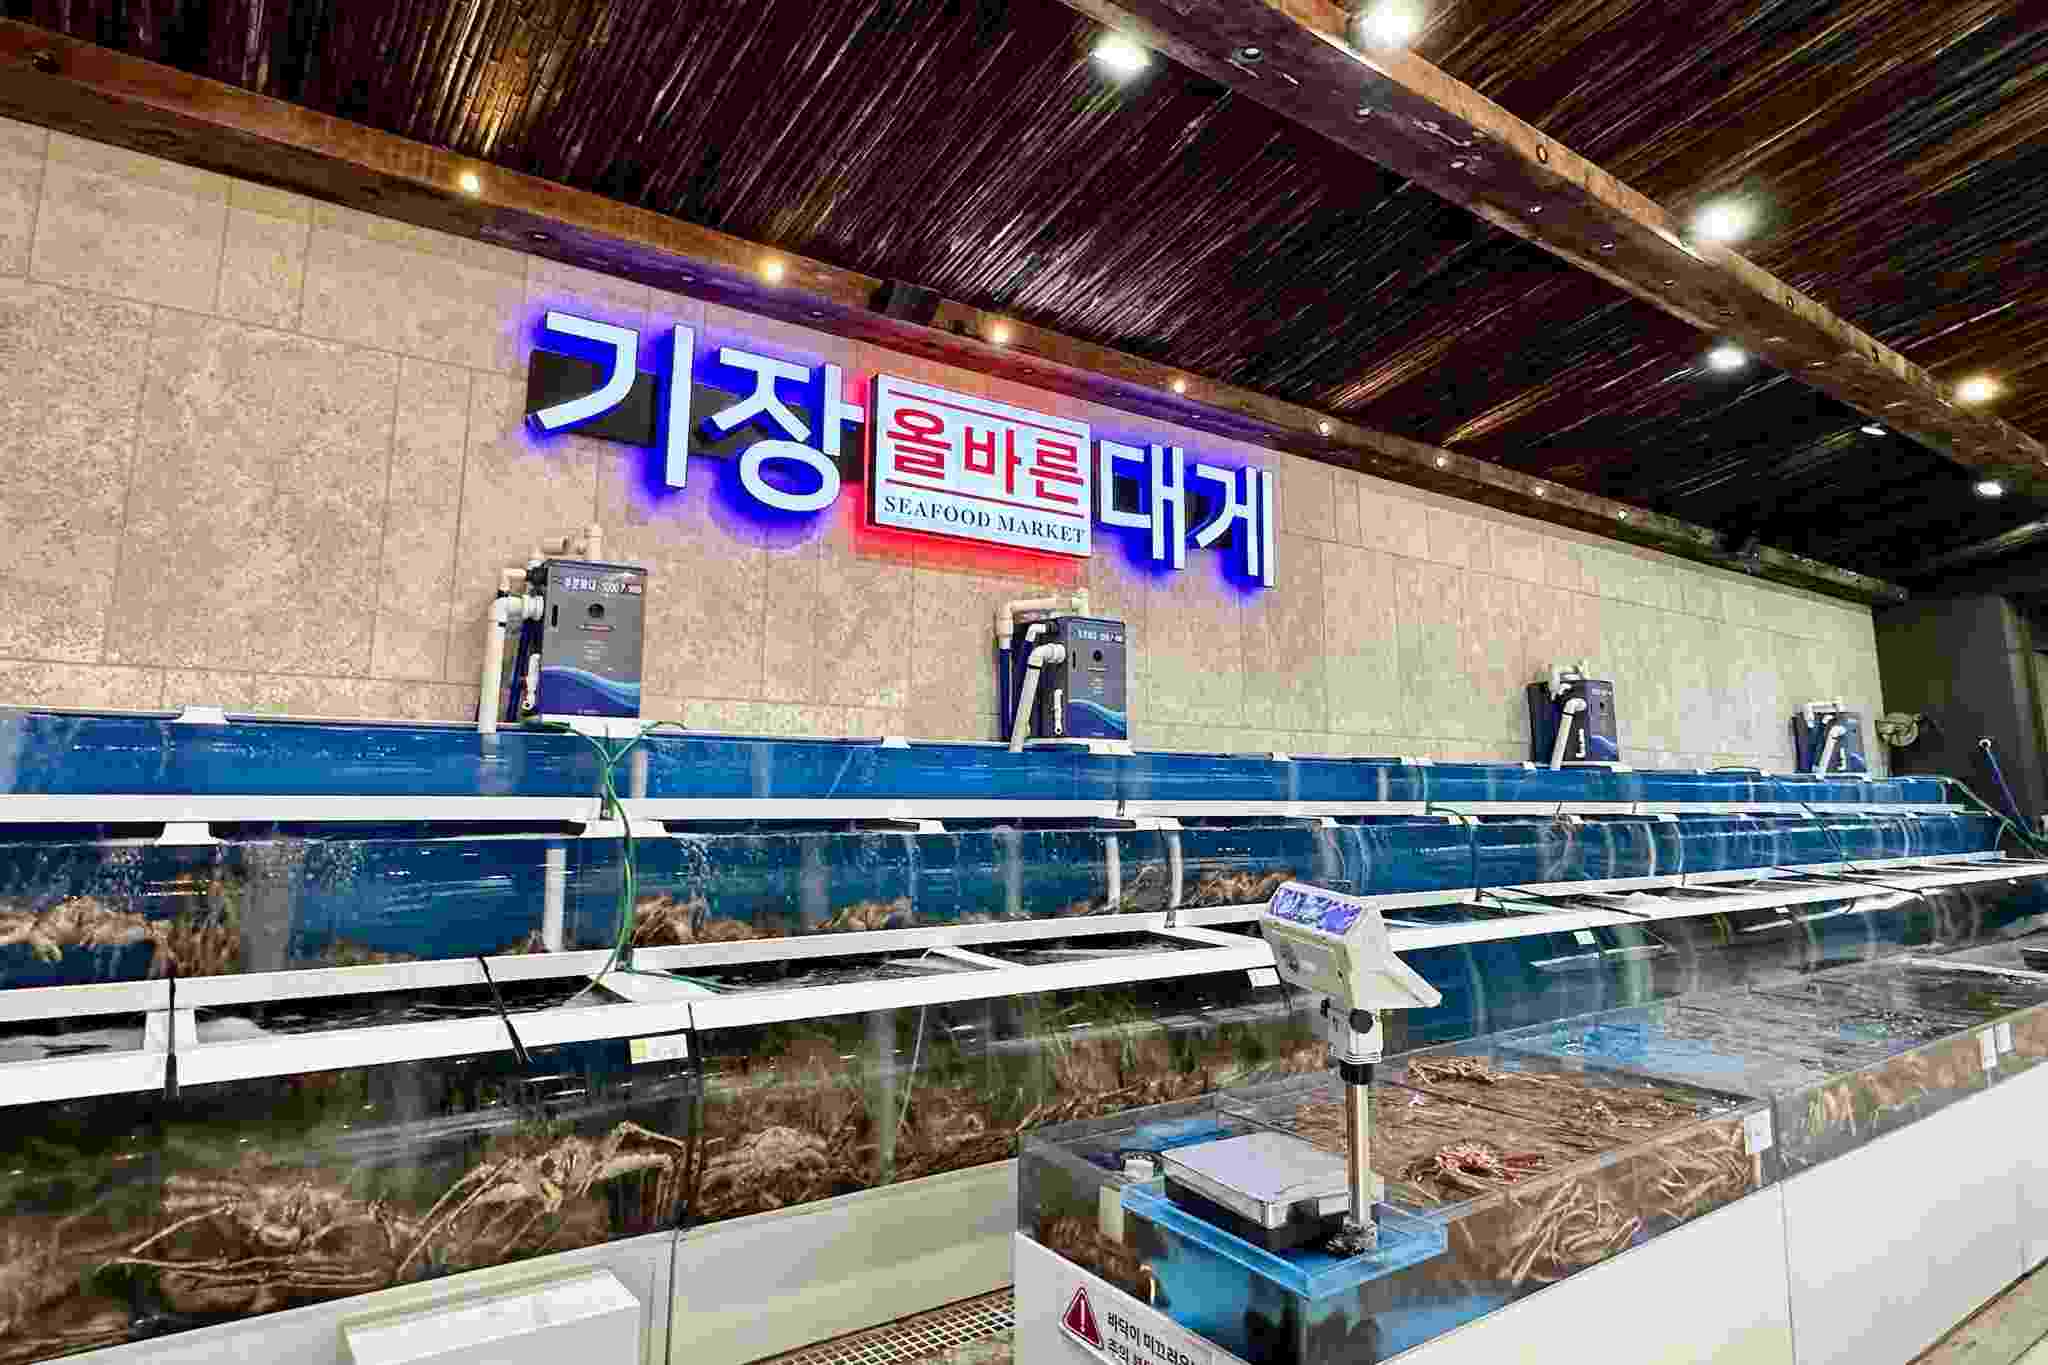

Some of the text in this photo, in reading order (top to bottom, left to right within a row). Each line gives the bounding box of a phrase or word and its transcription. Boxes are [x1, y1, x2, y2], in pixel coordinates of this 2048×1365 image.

[537, 311, 1273, 588] 기장 올바른 대게
[884, 496, 1086, 544] SEAFOOD MARKET
[1107, 1312, 1142, 1347] 바닥이
